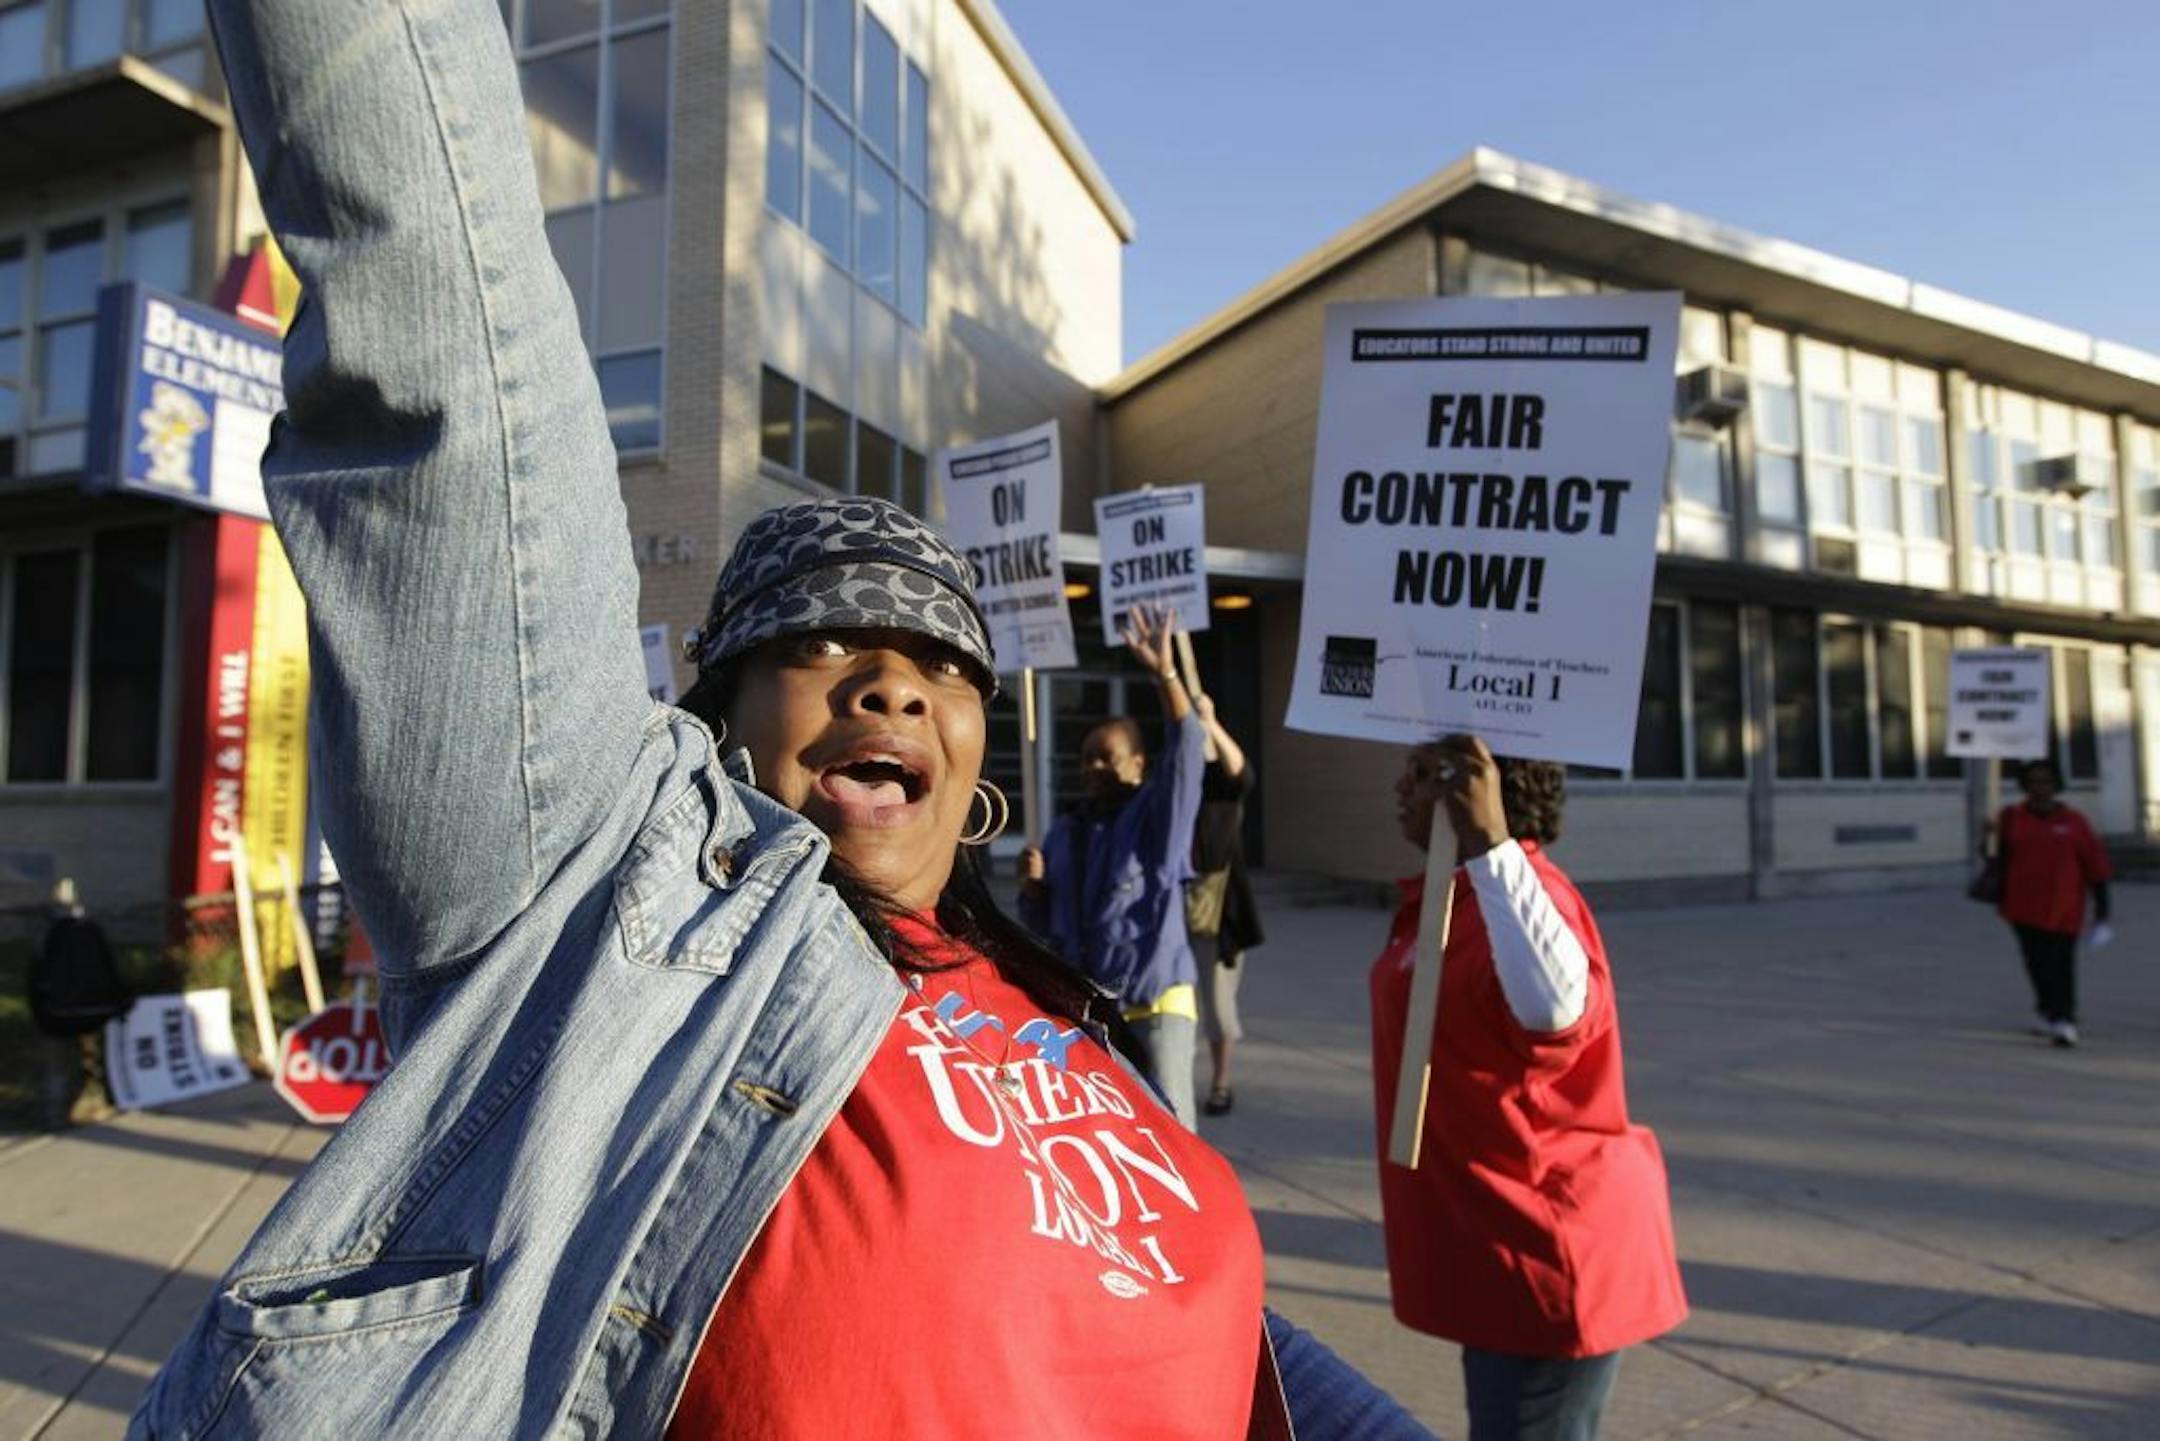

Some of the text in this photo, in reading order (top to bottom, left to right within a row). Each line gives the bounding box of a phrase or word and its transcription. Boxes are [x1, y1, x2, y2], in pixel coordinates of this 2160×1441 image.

[1358, 335, 1641, 356] EDUCATORS STAND STRONG AND UNITED
[1427, 394, 1545, 449] FAIR
[992, 479, 1026, 527] ON
[1340, 471, 1631, 536] CONTRACT
[1132, 514, 1165, 547] ON
[967, 534, 1053, 589] STRIKE
[1110, 548, 1195, 588] STRIKE
[1394, 550, 1545, 613] NOW!
[1448, 664, 1562, 701] Local 1
[216, 745, 244, 771] &
[135, 1036, 158, 1070] ON
[164, 1007, 199, 1091] STRIKE
[288, 1037, 386, 1083] TOP
